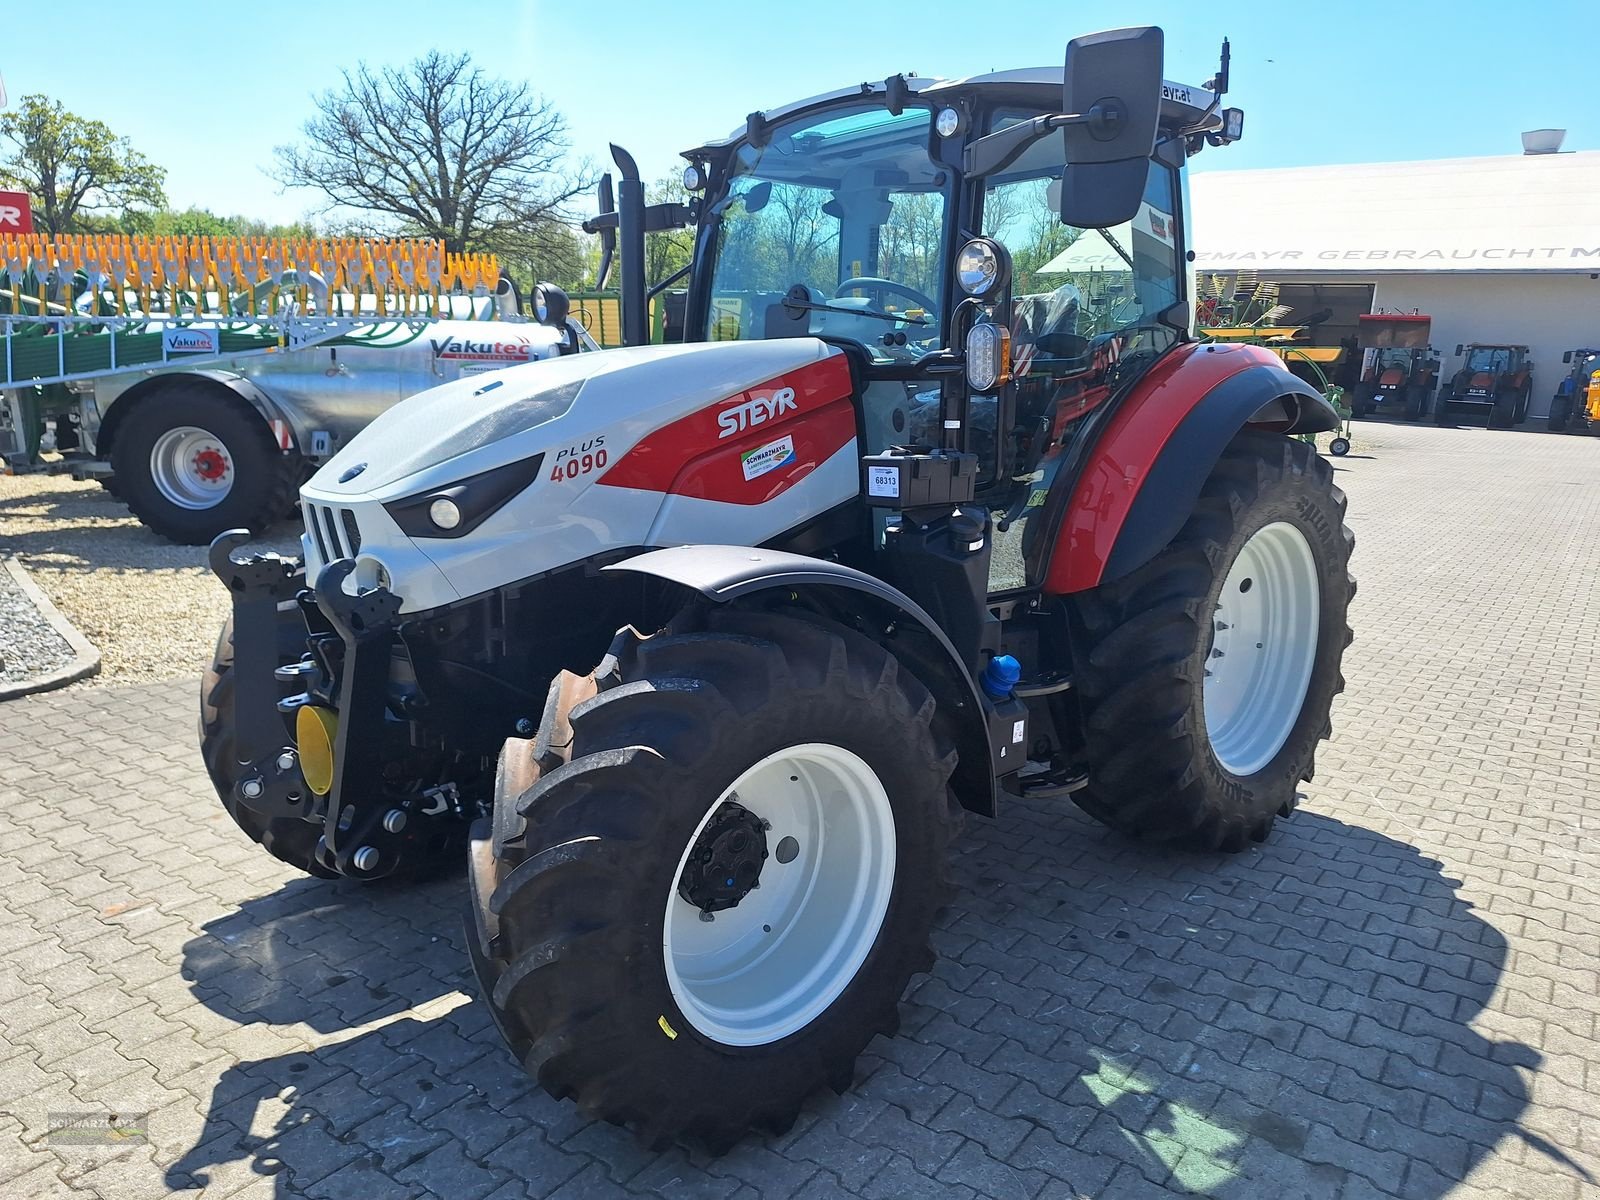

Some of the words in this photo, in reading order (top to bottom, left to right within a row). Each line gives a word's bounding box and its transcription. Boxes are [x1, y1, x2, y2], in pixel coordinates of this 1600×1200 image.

[1162, 85, 1191, 103] ayr.at
[1196, 250, 1303, 261] ZMAYR
[168, 335, 212, 348] Vakutec
[430, 335, 530, 358] Vakutec
[717, 387, 798, 439] STEYR
[556, 435, 605, 462] PLUS
[746, 444, 786, 465] SCHWARZMAYR
[550, 449, 608, 482] 4090
[875, 476, 896, 485] 68313
